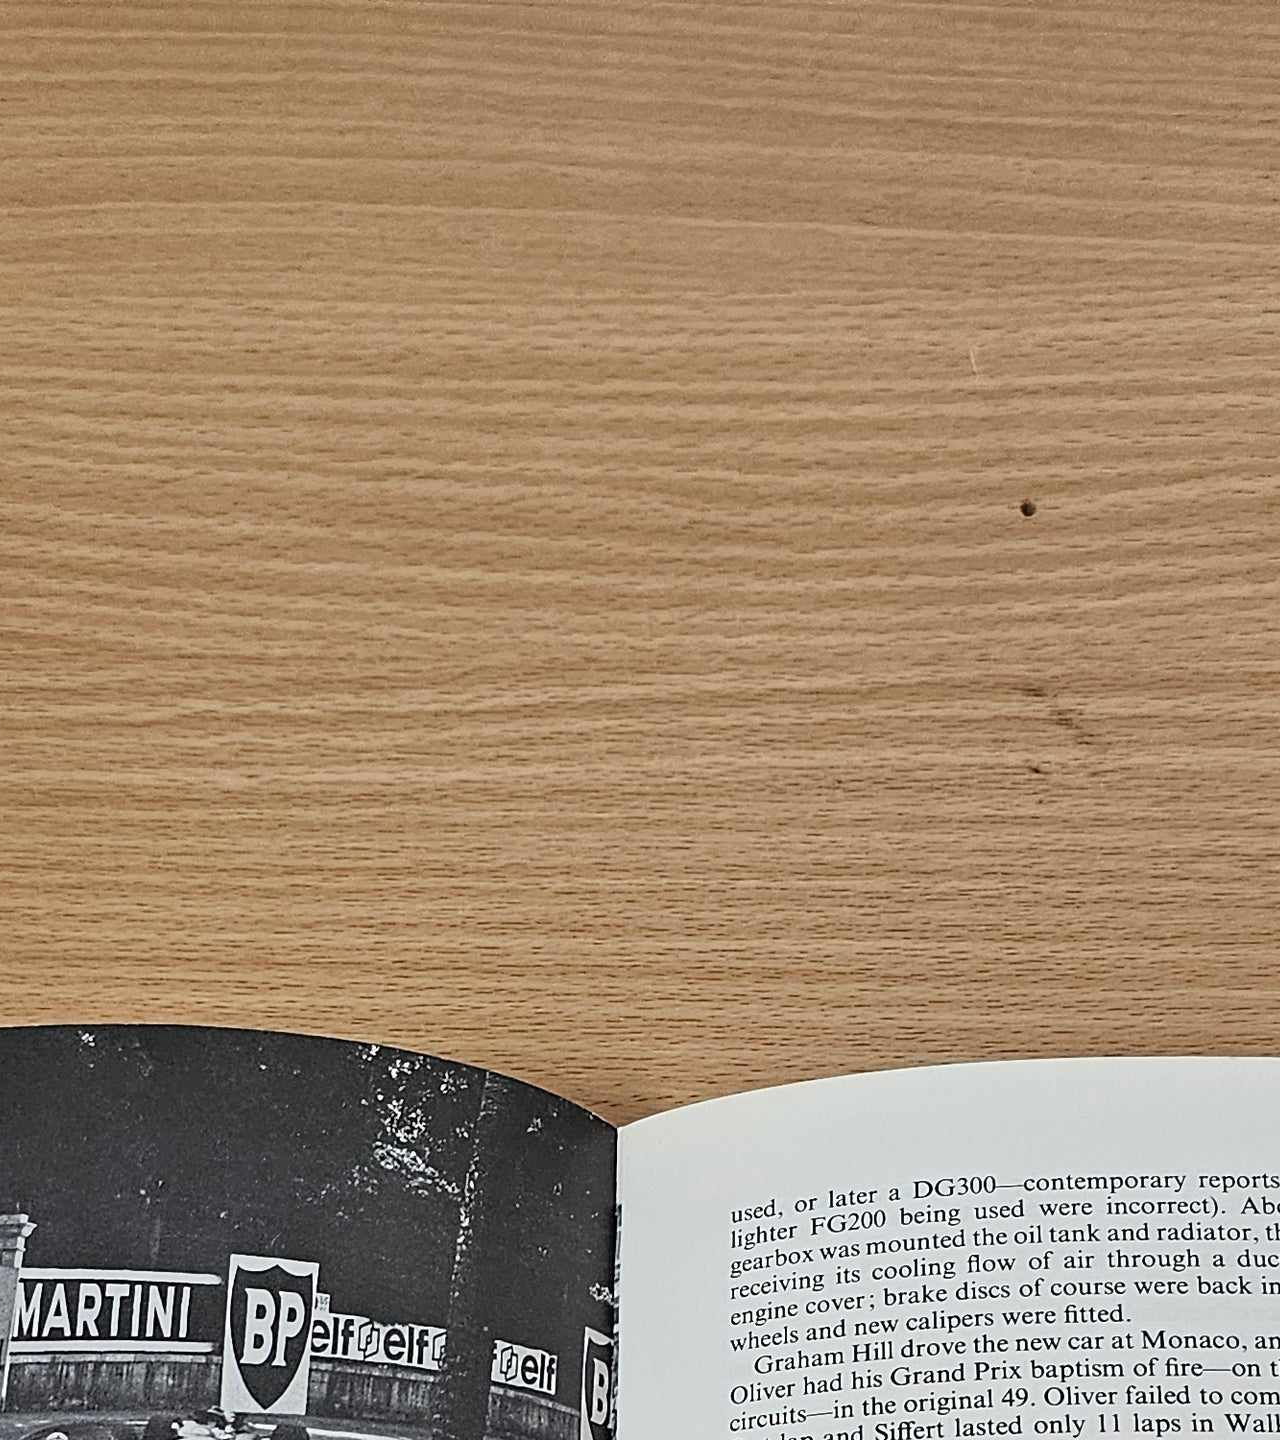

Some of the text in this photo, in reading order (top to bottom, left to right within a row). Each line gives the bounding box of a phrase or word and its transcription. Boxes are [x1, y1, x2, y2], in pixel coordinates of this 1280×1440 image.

[731, 1225, 798, 1250] lighter
[811, 1209, 886, 1236] FG200
[900, 1205, 961, 1226] being
[974, 1199, 1025, 1220] used
[1039, 1202, 1093, 1216] were
[1107, 1196, 1226, 1218] incorrect).
[12, 1282, 191, 1338] MARTINI
[239, 1287, 305, 1367] BP
[730, 1303, 1131, 1352] wheels and new calipers were fitted.
[311, 1317, 429, 1365] elf elf
[754, 1350, 845, 1374] Graham
[852, 1341, 893, 1363] Hill
[901, 1339, 966, 1358] drove
[973, 1334, 1009, 1354] the
[1015, 1337, 1061, 1351] new
[1068, 1336, 1105, 1350] car
[1112, 1333, 1134, 1349] at
[1141, 1330, 1247, 1352] Monaco,
[520, 1353, 556, 1391] elf
[590, 1357, 614, 1428] B
